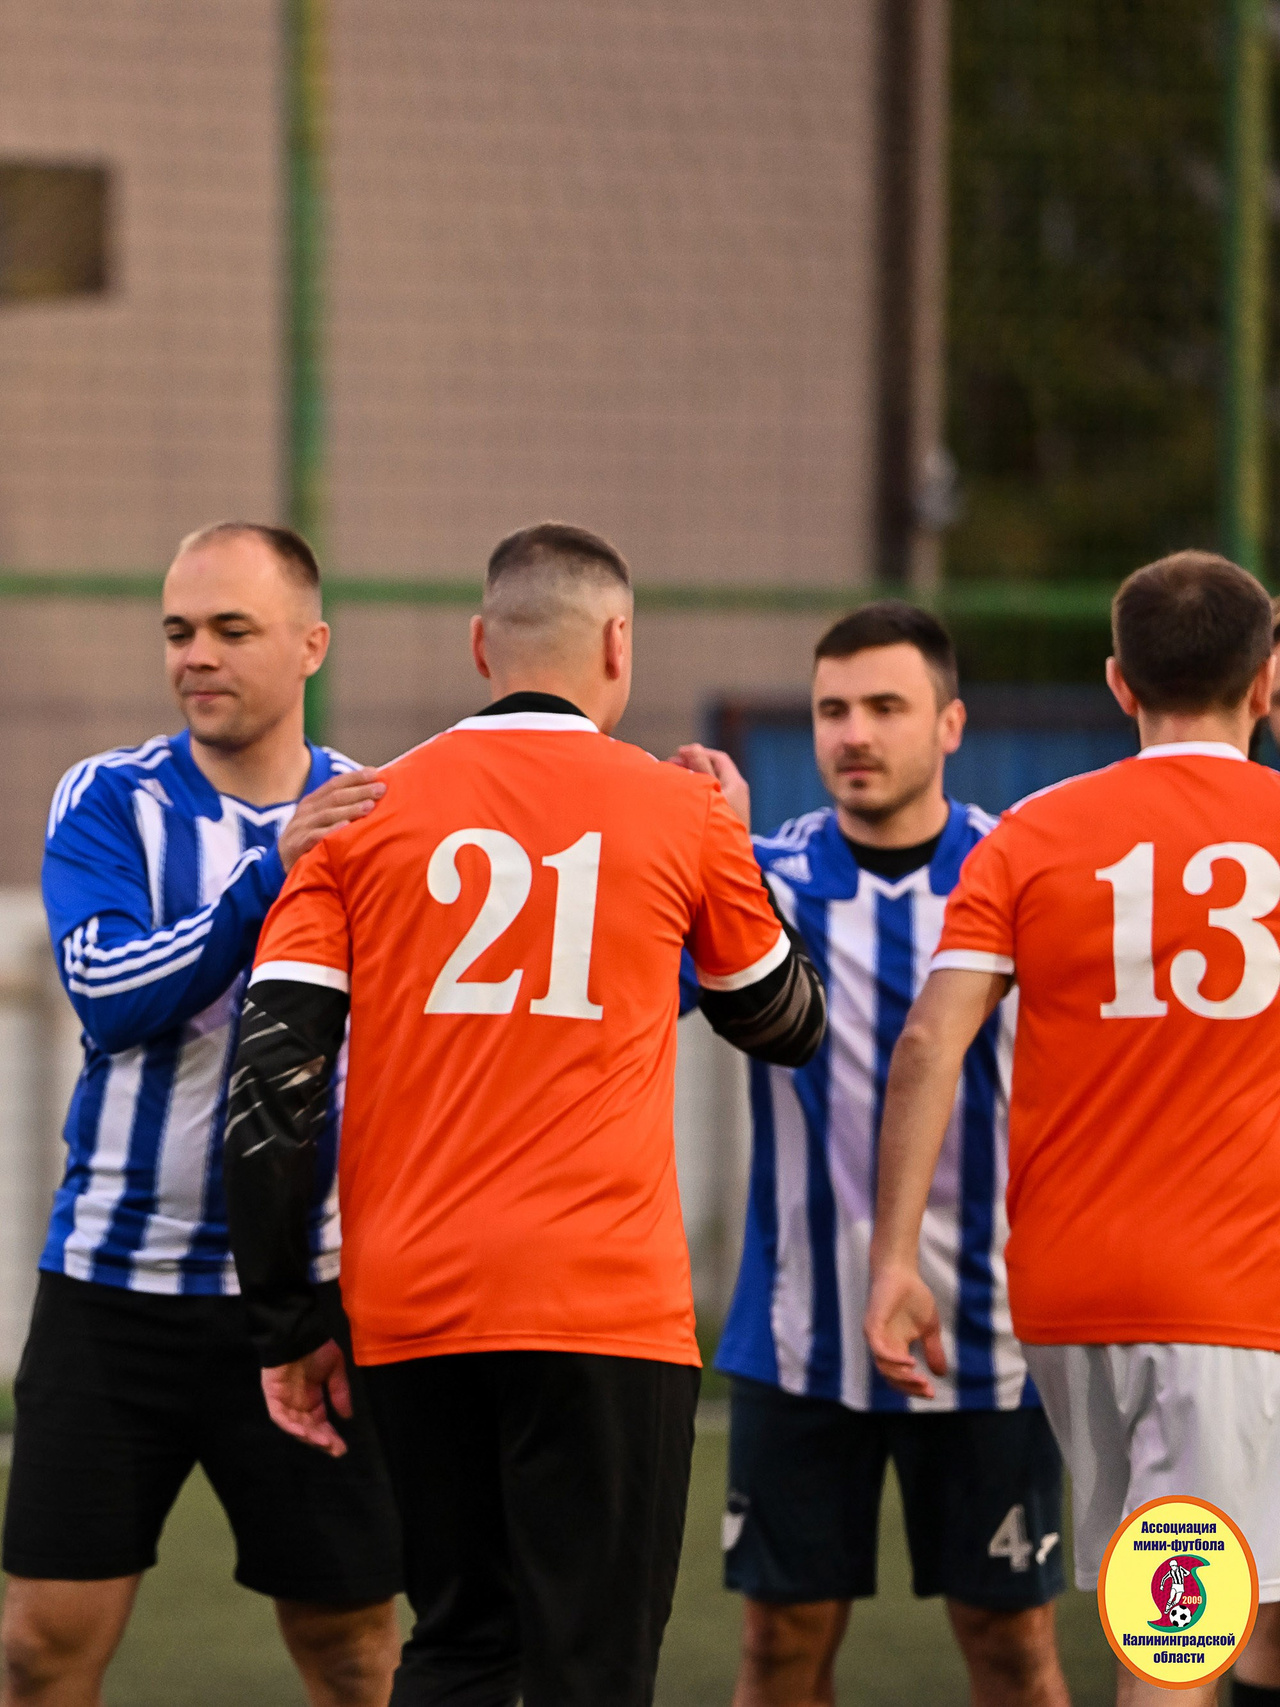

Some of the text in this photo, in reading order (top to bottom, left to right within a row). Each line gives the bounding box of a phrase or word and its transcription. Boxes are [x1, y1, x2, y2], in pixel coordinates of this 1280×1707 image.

[424, 828, 604, 1021] 21
[1094, 841, 1280, 1020] 13
[987, 1503, 1033, 1573] 4
